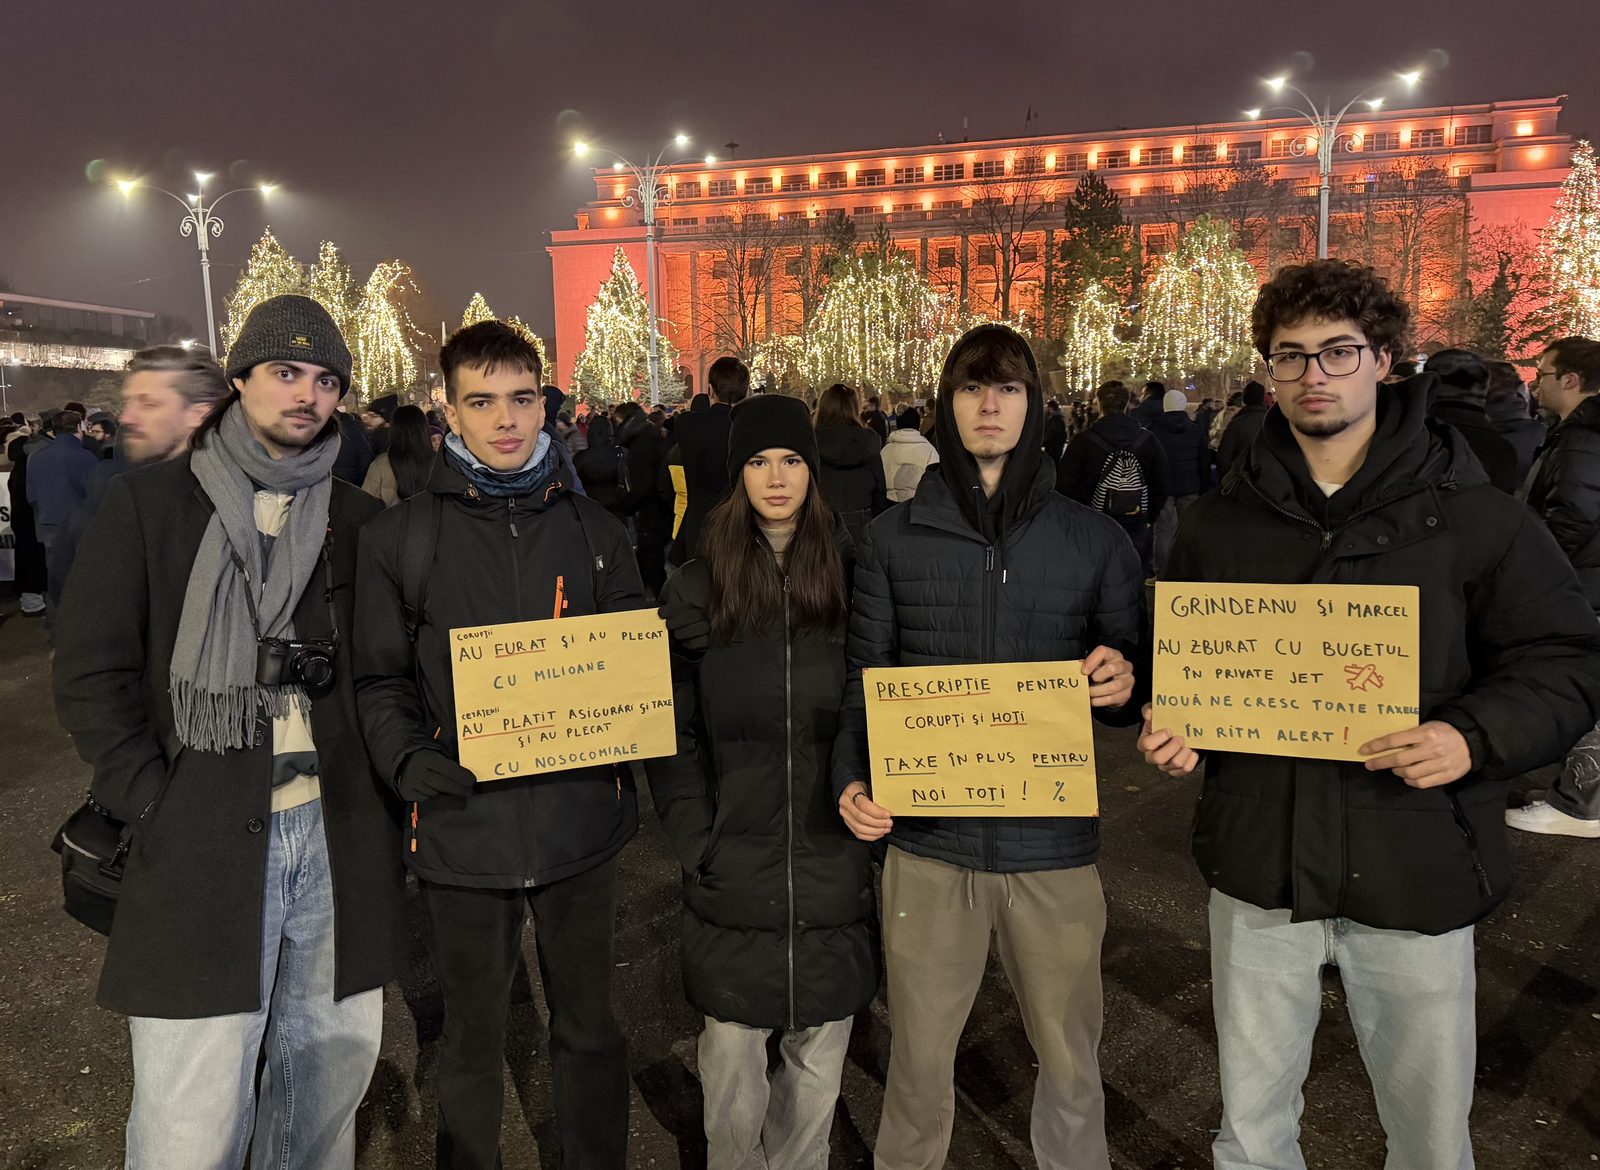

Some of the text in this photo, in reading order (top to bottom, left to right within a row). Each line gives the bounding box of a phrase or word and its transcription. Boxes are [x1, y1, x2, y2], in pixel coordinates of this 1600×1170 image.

[1170, 594, 1297, 618] GRINDEANU
[1347, 602, 1409, 618] MARCEL
[459, 646, 483, 662] AU
[494, 638, 547, 656] FURAT
[589, 631, 607, 642] AU
[621, 630, 664, 641] PLECAT
[1157, 638, 1410, 658] AU ZBURAT CU BUGETUL
[493, 661, 606, 690] CU MILIOANE
[1017, 678, 1079, 693] PENTRU
[1182, 666, 1324, 684] ÎN PRIVATE JET
[1210, 695, 1233, 708] NE
[1243, 696, 1300, 710] CRESC
[1312, 699, 1367, 714] TOATE
[1376, 703, 1420, 716] TAXELE
[462, 723, 483, 738] AU
[651, 699, 673, 710] TAXE
[540, 731, 557, 742] AU
[567, 722, 612, 738] PLECAT
[1185, 723, 1204, 737] ÎN
[1216, 725, 1260, 740] RITM
[494, 743, 639, 776] CU NOSOCOMIALE
[883, 751, 1089, 773] TAXE ÎN PLUS PENTRU
[911, 786, 946, 803] NOI
